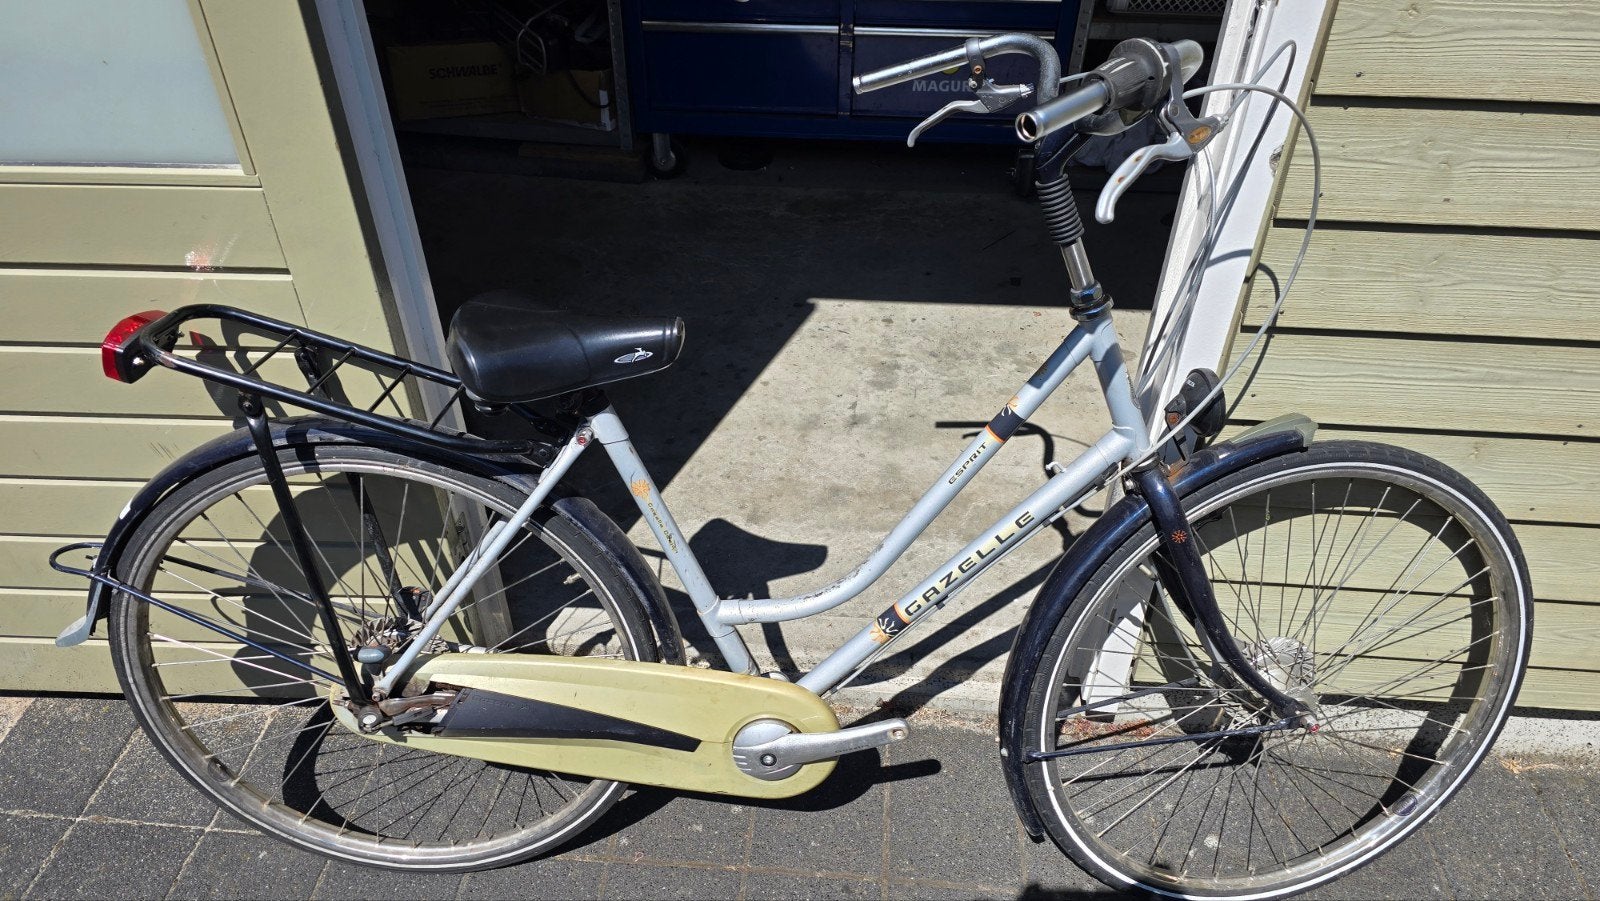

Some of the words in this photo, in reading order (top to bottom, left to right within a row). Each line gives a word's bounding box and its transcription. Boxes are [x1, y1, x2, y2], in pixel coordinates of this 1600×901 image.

[428, 64, 498, 79] SCHWALBE
[912, 80, 972, 92] MAGUR
[948, 441, 988, 485] ESPRIT
[904, 511, 1035, 617] GAZELLE
